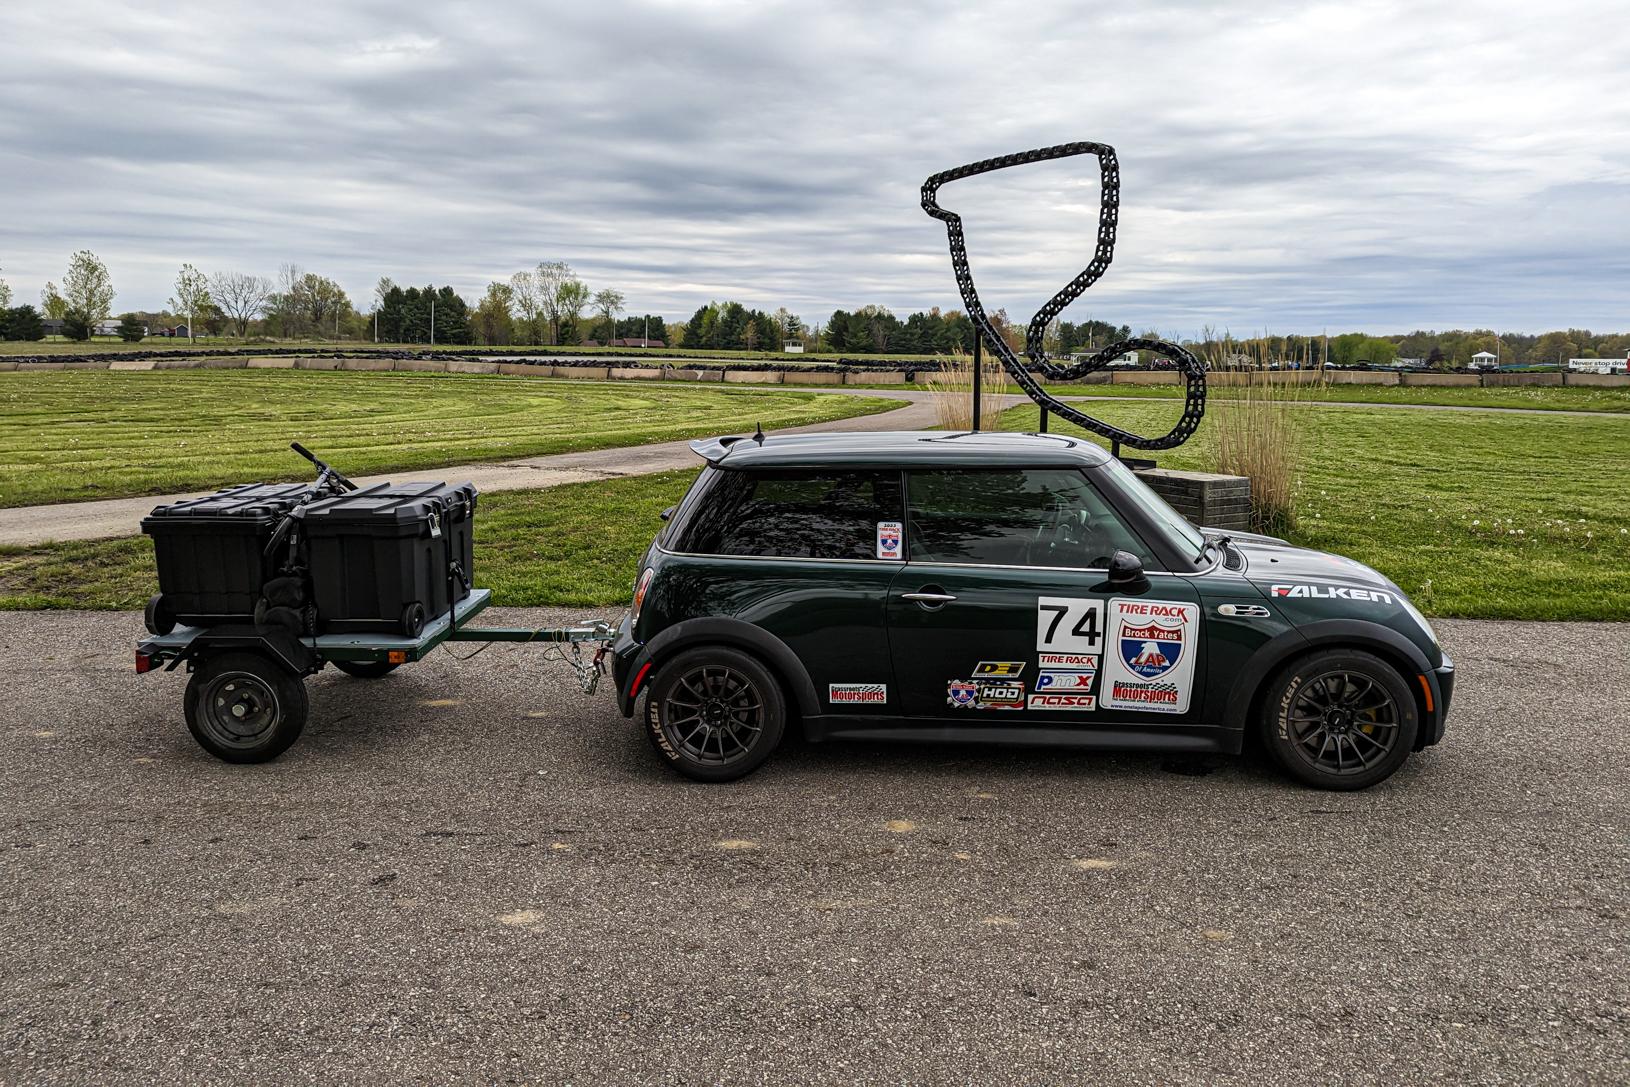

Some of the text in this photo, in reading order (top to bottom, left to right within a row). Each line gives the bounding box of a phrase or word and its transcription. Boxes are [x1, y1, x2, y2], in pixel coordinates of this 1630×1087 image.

[1270, 584, 1392, 605] FALKEN
[1118, 603, 1188, 624] TIRE RACK
[1039, 604, 1101, 647] 74
[1125, 628, 1181, 640] Brock Yates'
[1040, 655, 1096, 669] TIRE RACK
[1131, 652, 1167, 668] LAP
[1142, 666, 1163, 674] America
[1114, 680, 1150, 690] Grassroots
[831, 691, 885, 702] Motorsports
[1112, 686, 1179, 704] Motorsports
[1278, 676, 1302, 740] FALKEN
[650, 701, 680, 760] FALKEN
